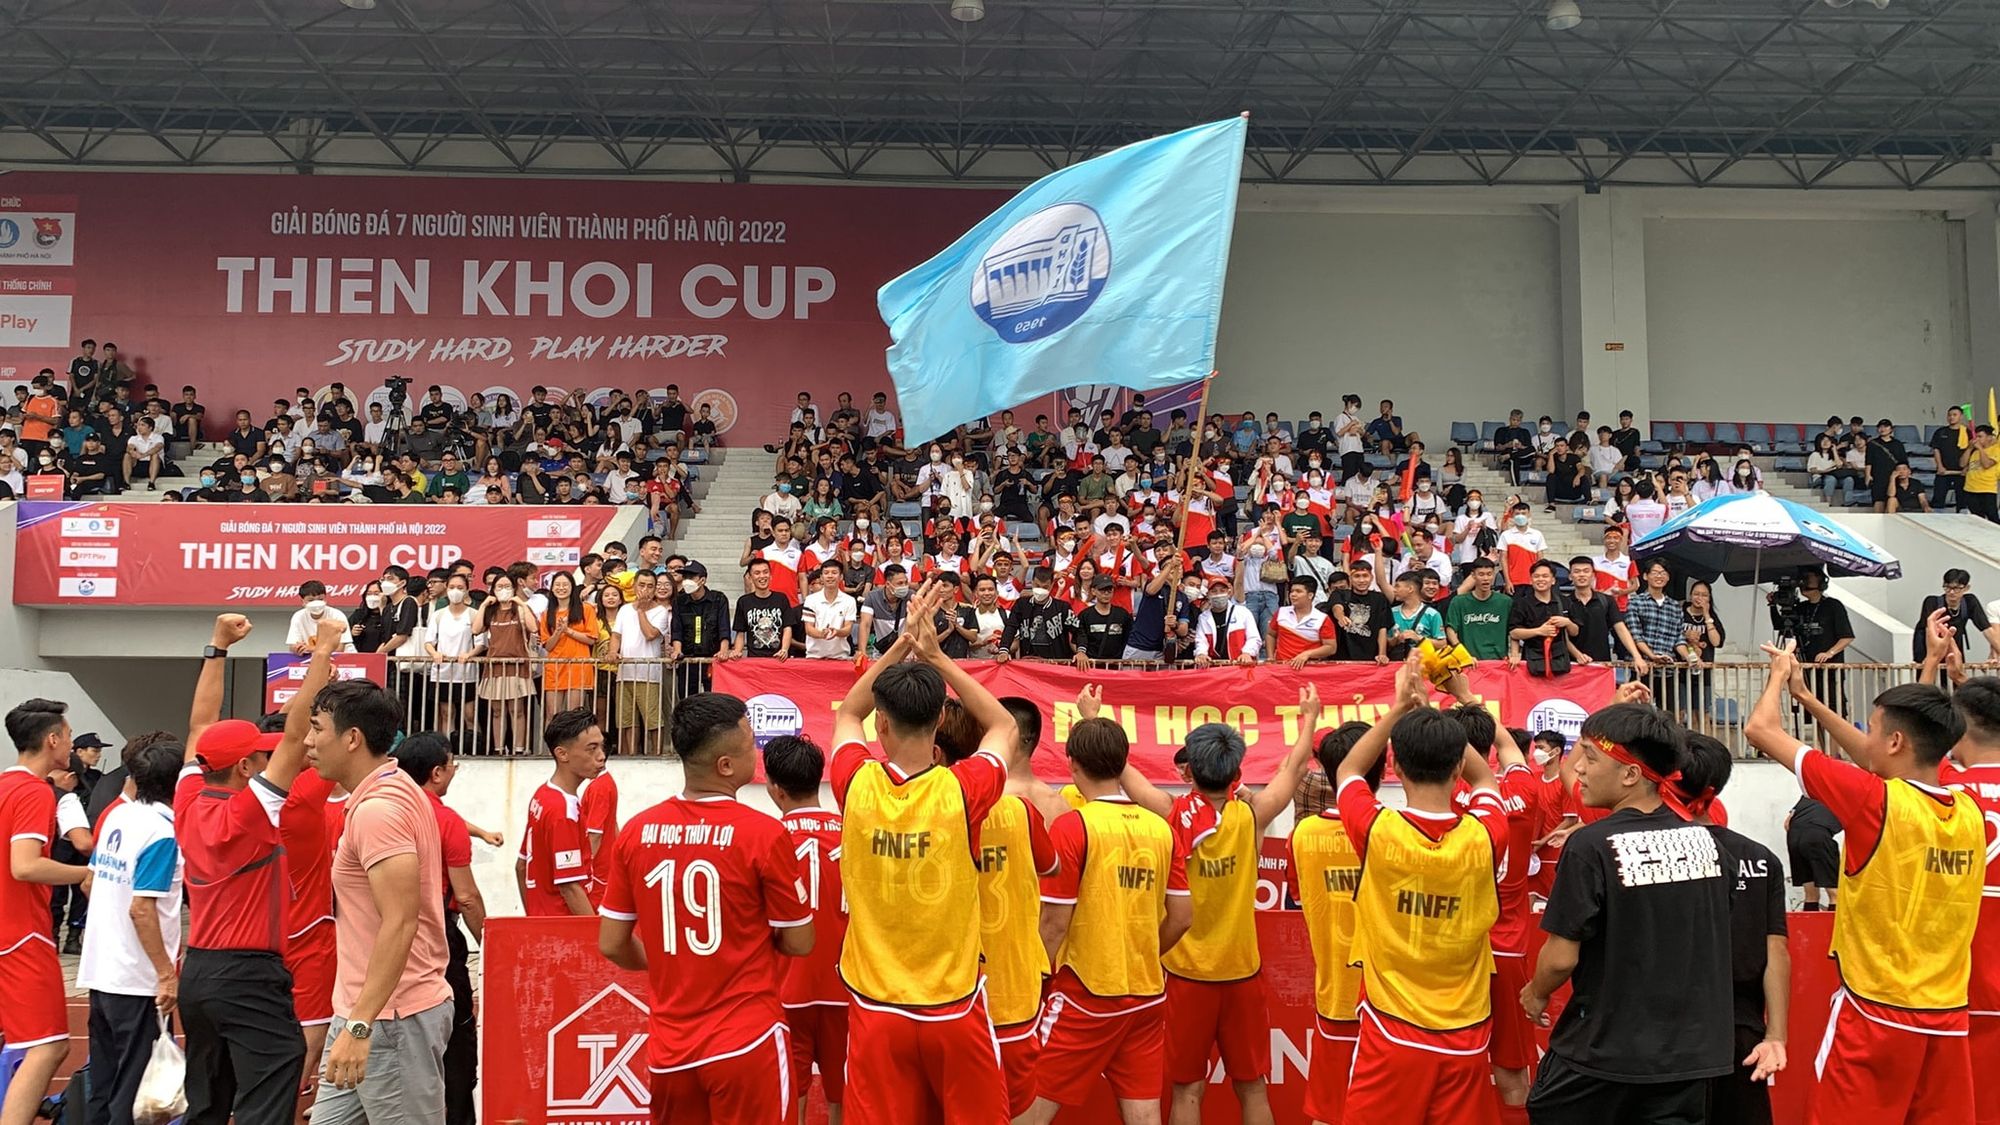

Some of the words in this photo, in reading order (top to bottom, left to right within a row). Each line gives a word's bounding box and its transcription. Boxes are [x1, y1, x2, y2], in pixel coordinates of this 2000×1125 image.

[271, 205, 307, 235] GIẢI
[312, 209, 361, 236] BÓNG
[365, 209, 390, 236] ĐÁ
[396, 214, 407, 236] 7
[412, 211, 467, 238] NGƯỜI
[471, 214, 515, 238] SINH
[519, 212, 561, 239] VIÊN
[566, 213, 629, 241] THÀNH
[633, 213, 672, 241] PHỐ
[674, 215, 700, 242] HÀ
[703, 216, 735, 246] NỘI
[739, 220, 787, 244] 2022
[3, 278, 28, 290] THỐNG
[29, 280, 52, 291] CHÍNH
[462, 259, 653, 318] KHOI
[680, 263, 836, 320] CUP
[1, 314, 38, 333] Play
[324, 338, 425, 367] STUDY
[428, 336, 515, 367] HARD,
[530, 335, 604, 361] PLAY
[607, 335, 729, 361] HARDER
[220, 519, 236, 533] GIẢI
[238, 521, 260, 533] BÓNG
[262, 521, 273, 533] ĐÁ
[274, 523, 280, 533] 7
[281, 521, 306, 533] NGƯỜI
[307, 523, 327, 533] SINH
[328, 522, 347, 534] VIÊN
[349, 522, 376, 534] THÀNH
[378, 521, 396, 534] PHỐ
[396, 522, 407, 534] HÀ
[409, 522, 423, 536] NỘI
[424, 524, 446, 534] 2022
[290, 543, 377, 570] KHOI
[389, 544, 462, 570] CUP
[226, 587, 272, 599] STUDY
[641, 823, 658, 848] ĐẠI
[659, 825, 682, 849] HỌC
[685, 818, 710, 846] THỦY
[712, 825, 735, 847] LỢI
[799, 818, 821, 832] HỌC
[872, 829, 930, 860] HNFF
[644, 859, 723, 955] 19
[1397, 889, 1462, 919] HNFF
